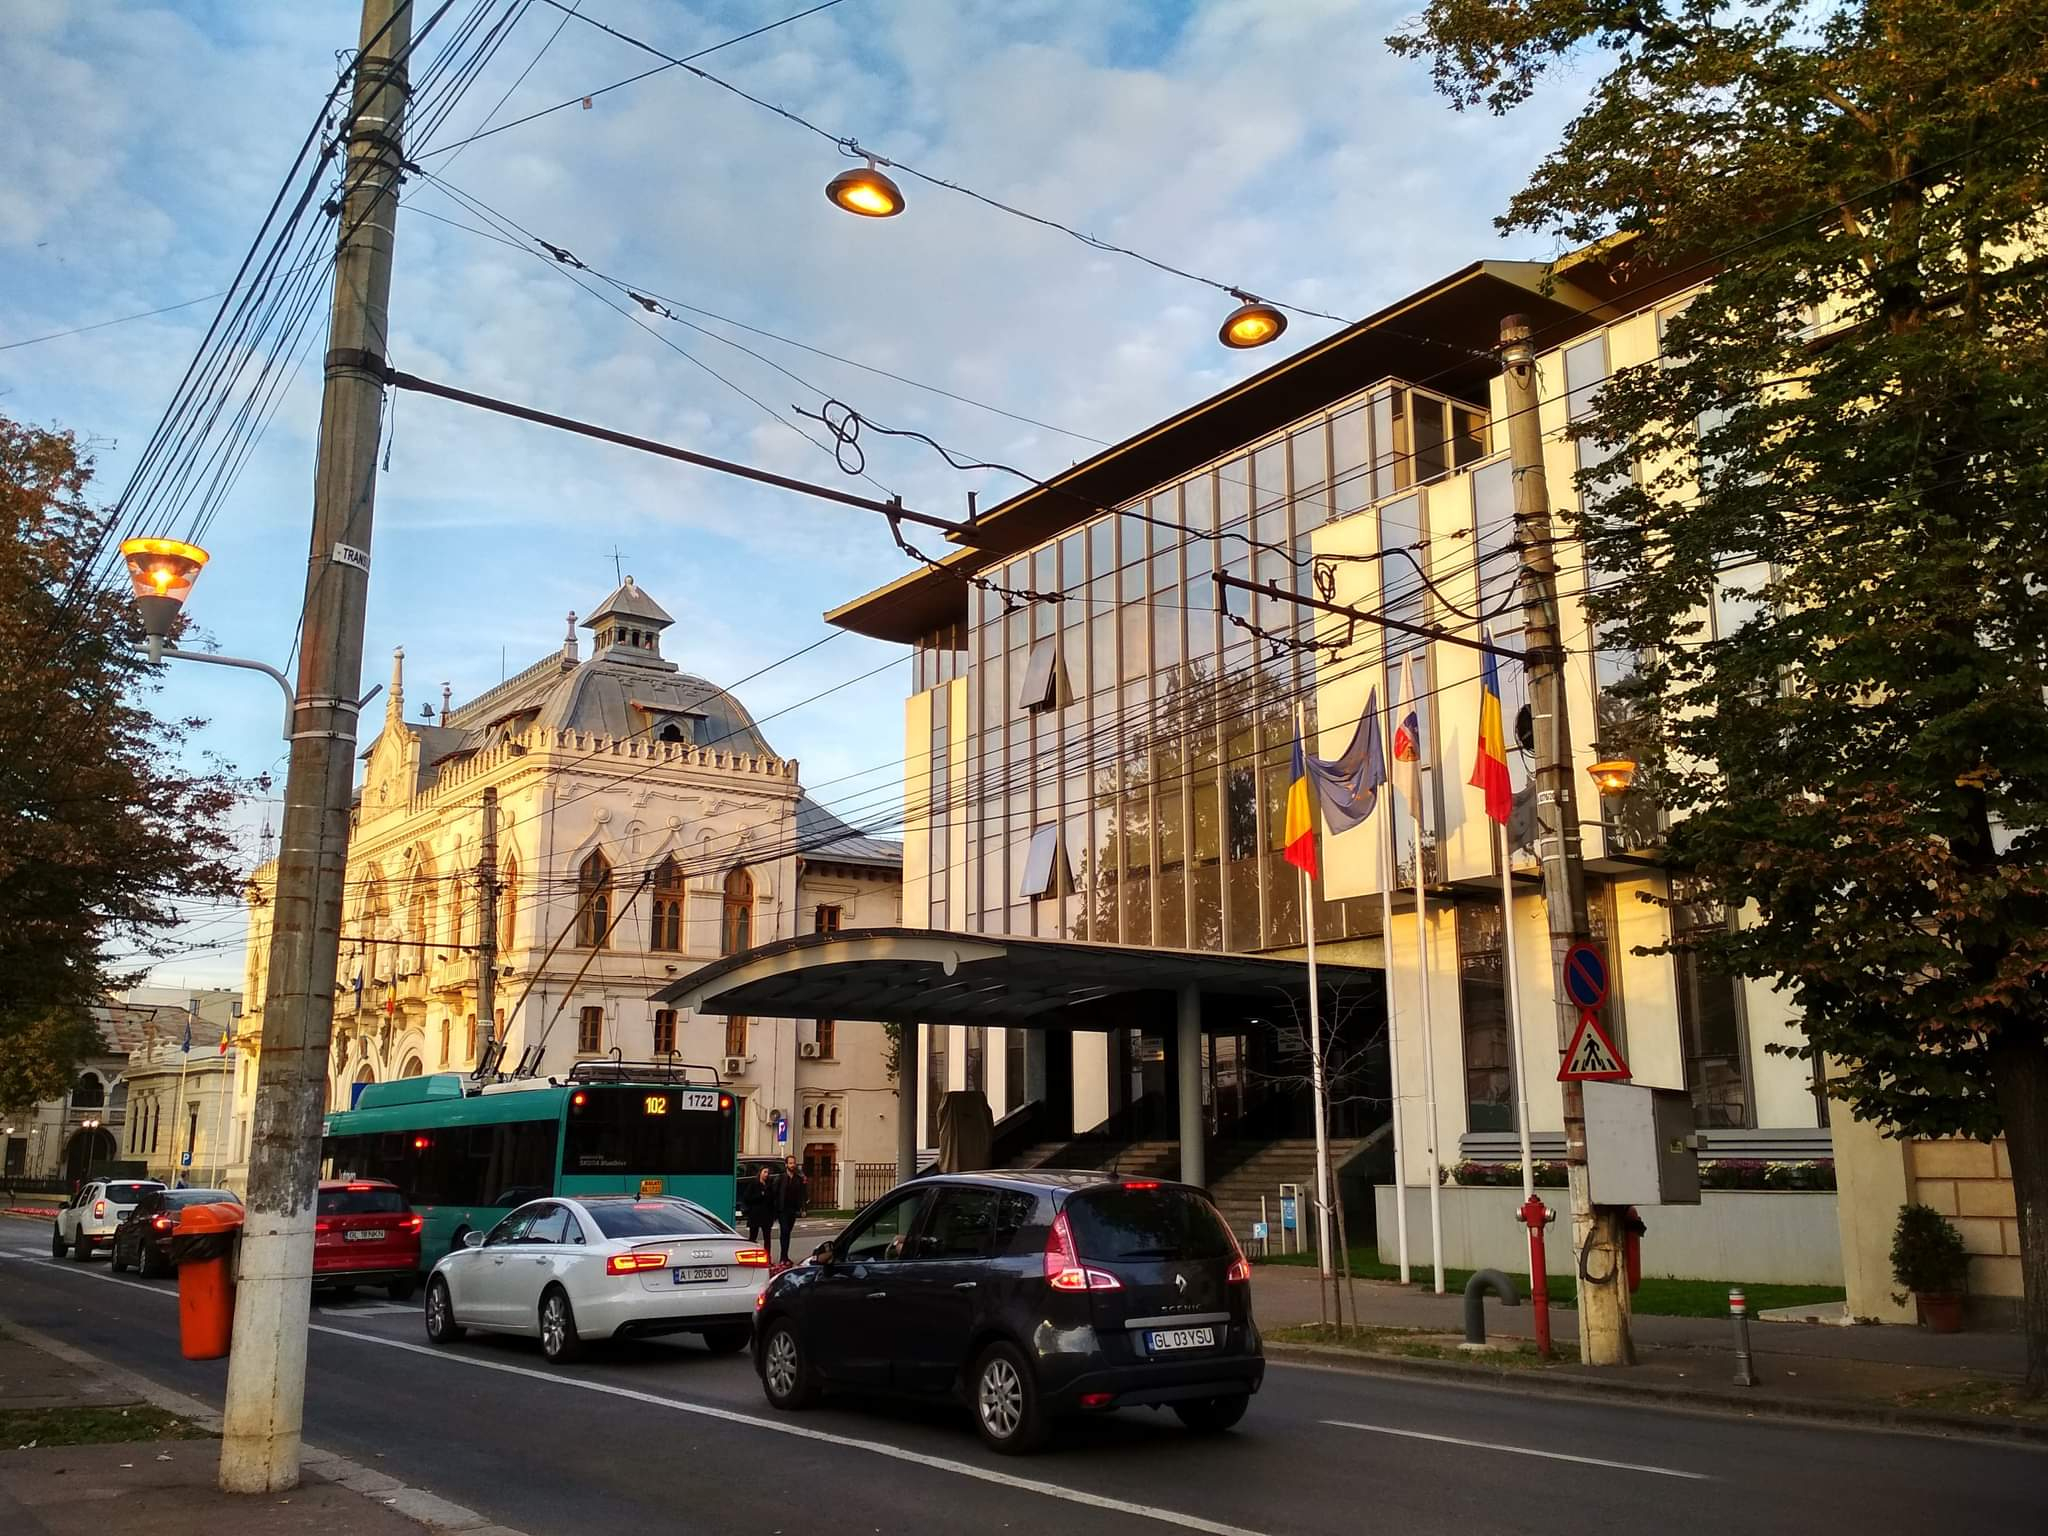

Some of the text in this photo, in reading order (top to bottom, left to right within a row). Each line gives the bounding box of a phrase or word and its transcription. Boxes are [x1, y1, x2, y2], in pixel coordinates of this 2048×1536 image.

[646, 1097, 666, 1114] 102
[688, 1095, 713, 1107] 1722
[694, 1269, 712, 1279] 2058
[1154, 1333, 1171, 1348] GL
